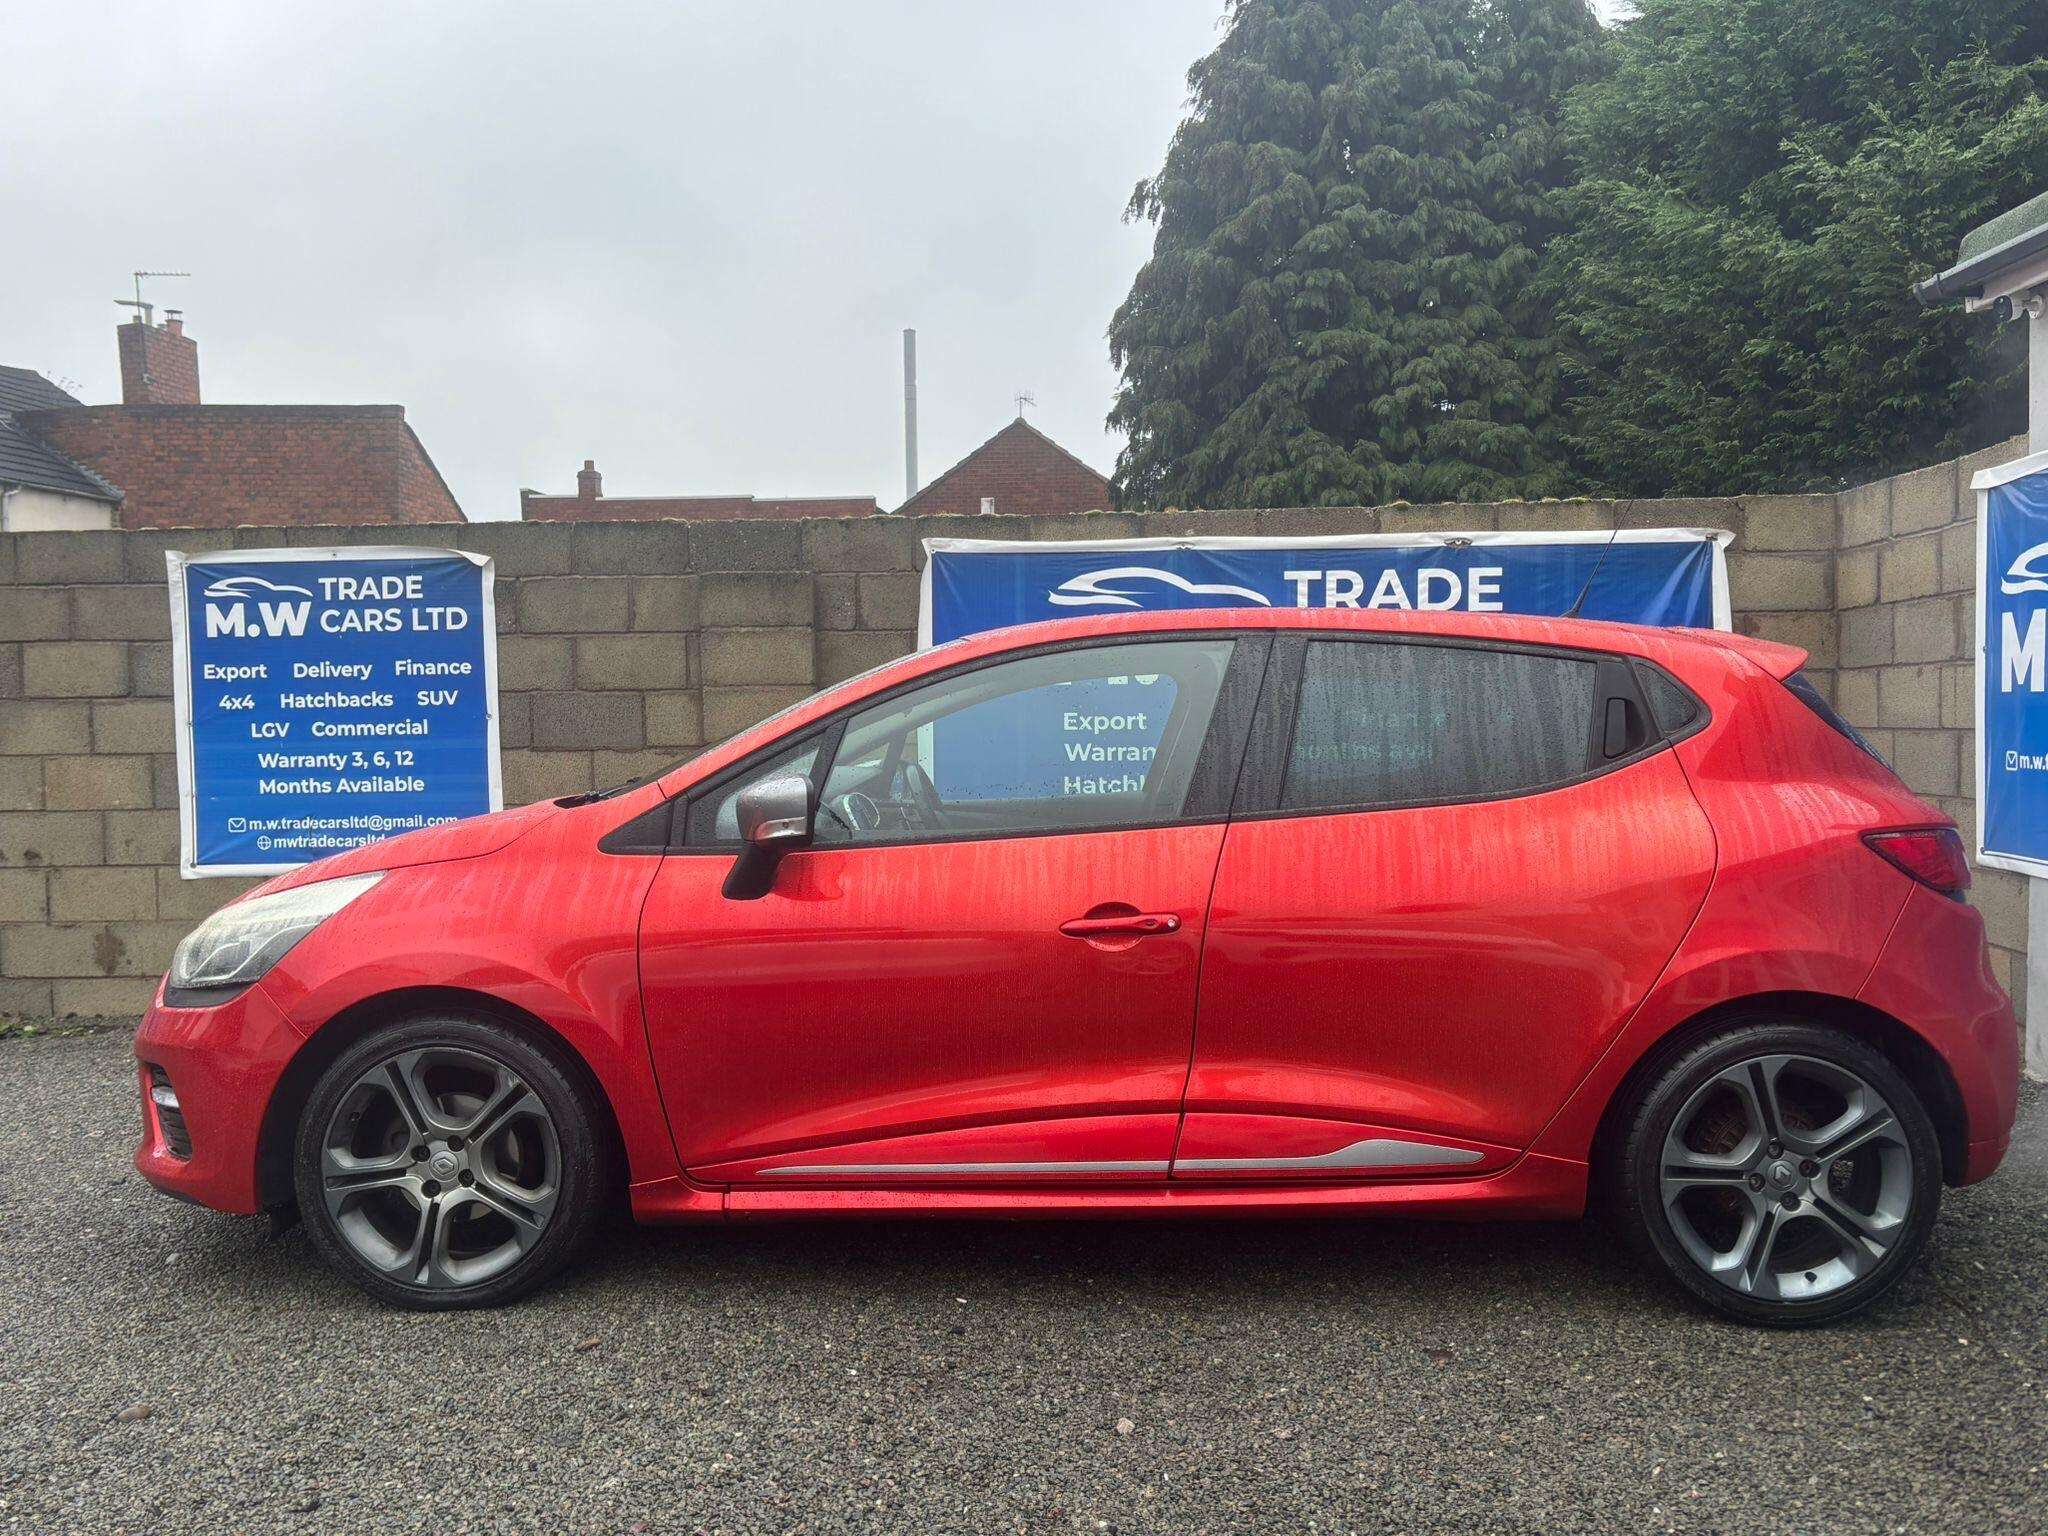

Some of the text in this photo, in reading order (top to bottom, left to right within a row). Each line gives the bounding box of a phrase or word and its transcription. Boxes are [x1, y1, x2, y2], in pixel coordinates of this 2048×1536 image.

[319, 575, 423, 601] TRADE
[1283, 567, 1503, 611] TRADE
[205, 602, 311, 638] M.W
[320, 606, 468, 633] CARS LTD
[204, 659, 472, 681] Export Delivery Finance
[219, 690, 458, 710] 4x4 Hatchbacks SUV
[251, 718, 428, 738] LGV Commercial
[1063, 712, 1147, 735] Export
[258, 751, 414, 771] Warranty 3, 6, 12
[1064, 743, 1156, 761] Warran
[259, 776, 424, 794] Months Available
